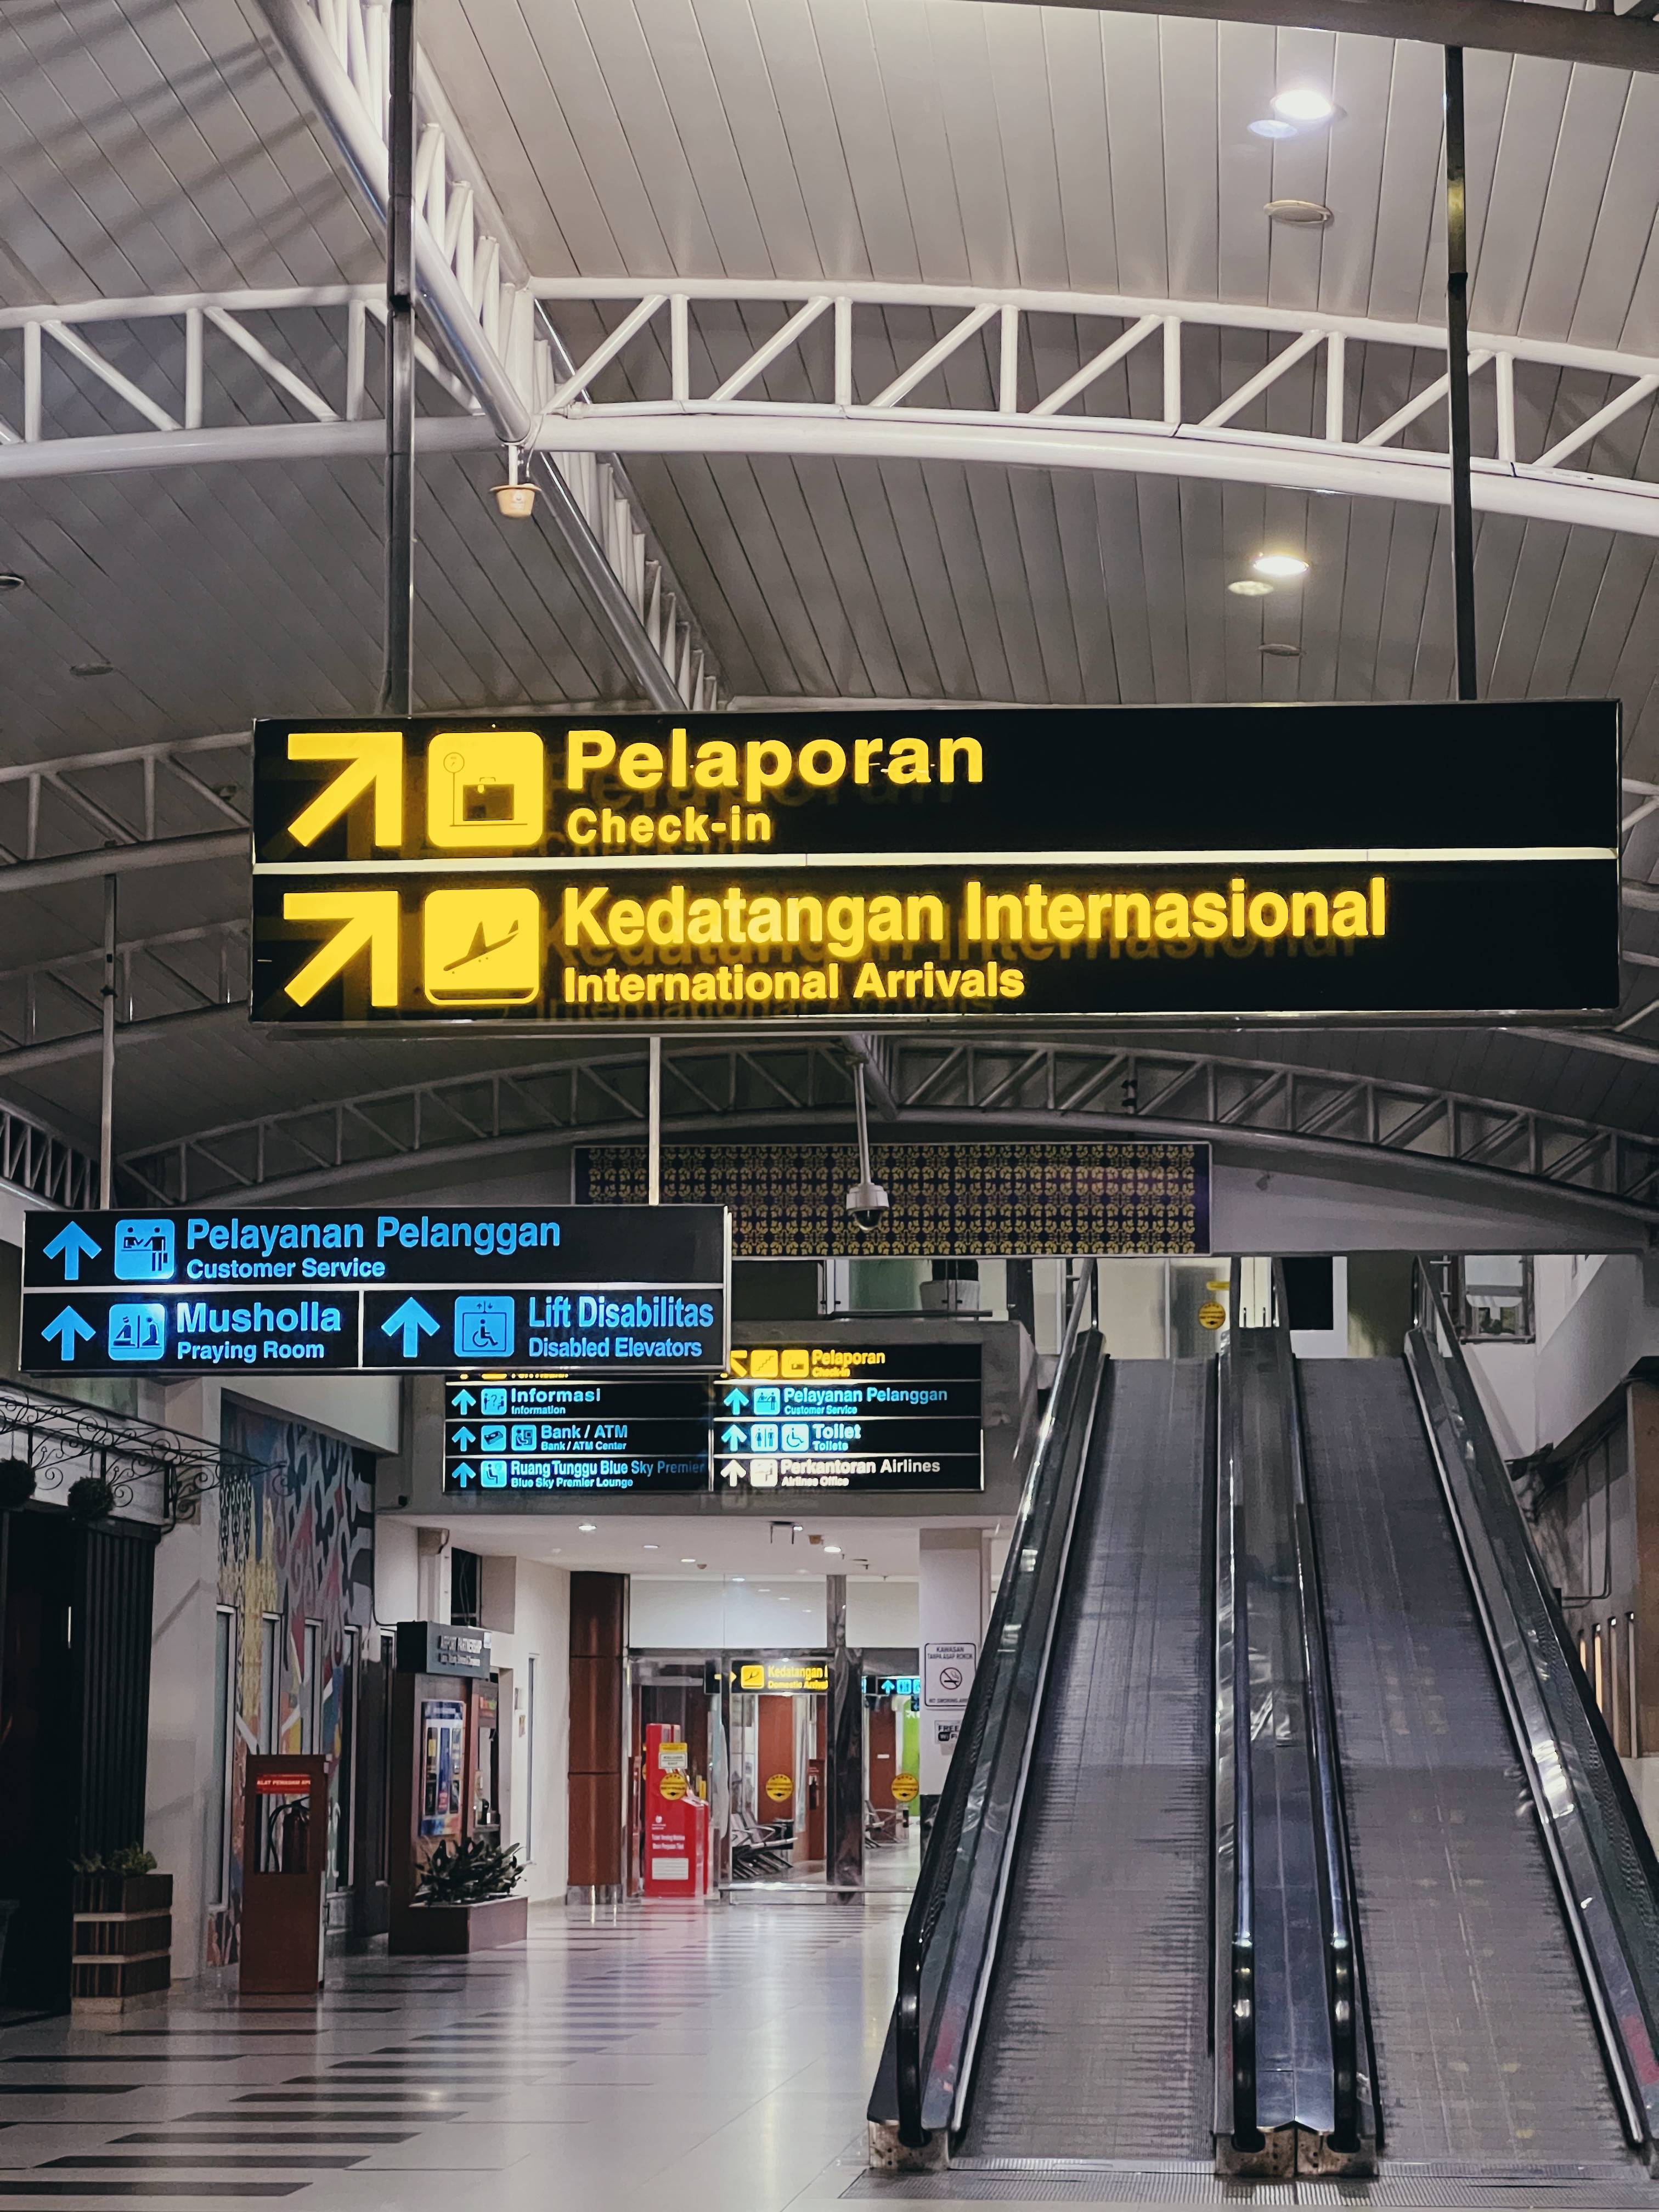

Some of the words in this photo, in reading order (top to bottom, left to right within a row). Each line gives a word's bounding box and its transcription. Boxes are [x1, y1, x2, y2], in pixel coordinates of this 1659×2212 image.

[568, 729, 982, 801] Pelaporan
[568, 805, 770, 844] Check-in
[566, 886, 943, 956] Kedatangan
[968, 877, 1385, 939] Internasional
[566, 964, 838, 1002] International
[854, 962, 1024, 997] Arrivals
[188, 1218, 363, 1256] Pelayanan
[377, 1216, 560, 1255] Pelanggan
[187, 1259, 296, 1279] Customer
[302, 1257, 385, 1277] Service
[176, 1301, 341, 1333] Musholla
[529, 1296, 571, 1328] Lift
[579, 1296, 713, 1328] Disabilitas
[178, 1341, 256, 1363] Praying
[264, 1341, 324, 1358] Room
[529, 1337, 610, 1357] Disabled
[615, 1337, 702, 1357] Elevators
[812, 1350, 885, 1366] Pelaporan
[812, 1367, 850, 1378] Check-in
[511, 1388, 600, 1402] Informasi
[784, 1387, 862, 1403] Pelayanan
[866, 1387, 947, 1404] Pelanggan
[511, 1406, 566, 1414] Information
[784, 1406, 825, 1415] Customer
[826, 1406, 857, 1414] Service
[541, 1425, 581, 1438] Bank
[584, 1425, 590, 1438] /
[594, 1425, 627, 1438] ATM
[812, 1424, 861, 1440] Toilet
[541, 1441, 565, 1451] Bank
[567, 1441, 571, 1451] /
[573, 1441, 593, 1450] ATM
[595, 1441, 627, 1450] Center
[813, 1441, 848, 1452] Toilets
[511, 1460, 550, 1476] Ruang
[552, 1460, 597, 1476] Tunggu
[600, 1460, 628, 1474] Blue
[631, 1461, 653, 1476] Sky
[658, 1461, 704, 1473] Premier
[781, 1459, 876, 1474] Perkantoran
[880, 1459, 940, 1473] Airlines
[510, 1477, 534, 1487] Blue
[535, 1477, 554, 1489] Sky
[556, 1477, 595, 1487] Premier
[596, 1477, 633, 1488] Lounge
[782, 1476, 819, 1486] Airlines
[820, 1476, 849, 1486] Office
[768, 1665, 823, 1680] Kedatangan
